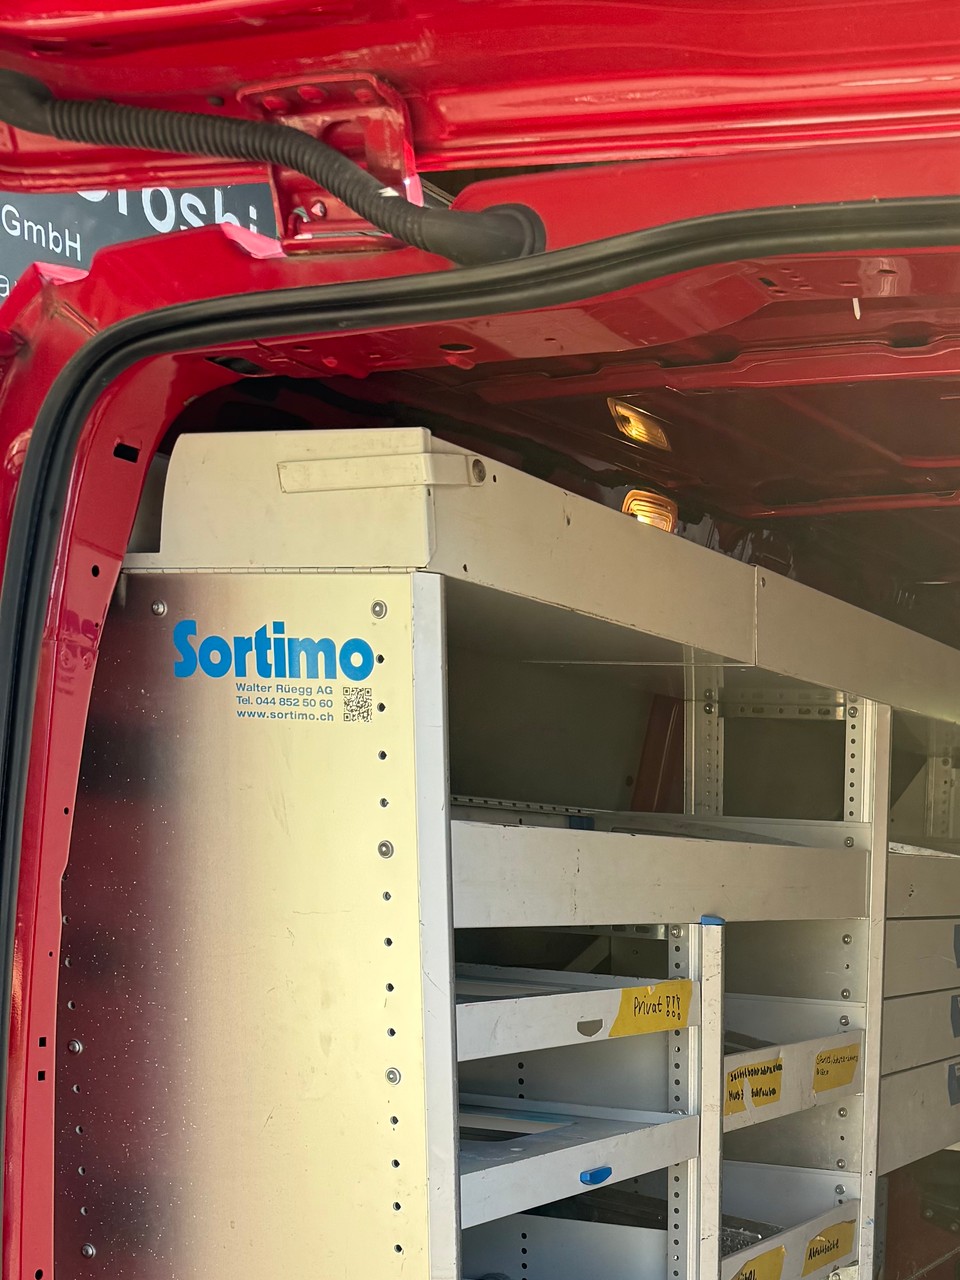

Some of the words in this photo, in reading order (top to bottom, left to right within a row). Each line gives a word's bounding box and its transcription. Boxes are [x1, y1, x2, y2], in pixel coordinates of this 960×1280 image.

[1, 204, 81, 262] GmbH
[173, 619, 375, 682] Sortimo
[236, 682, 272, 693] Walter
[275, 683, 313, 697] Rüegg
[316, 685, 333, 695] AG
[236, 695, 253, 705] Tel.
[255, 696, 276, 706] 044
[278, 697, 300, 707] 852
[302, 698, 317, 708] 50
[319, 699, 334, 708] 60
[236, 710, 334, 722] www.sortimo.ch
[633, 995, 663, 1017] Privat
